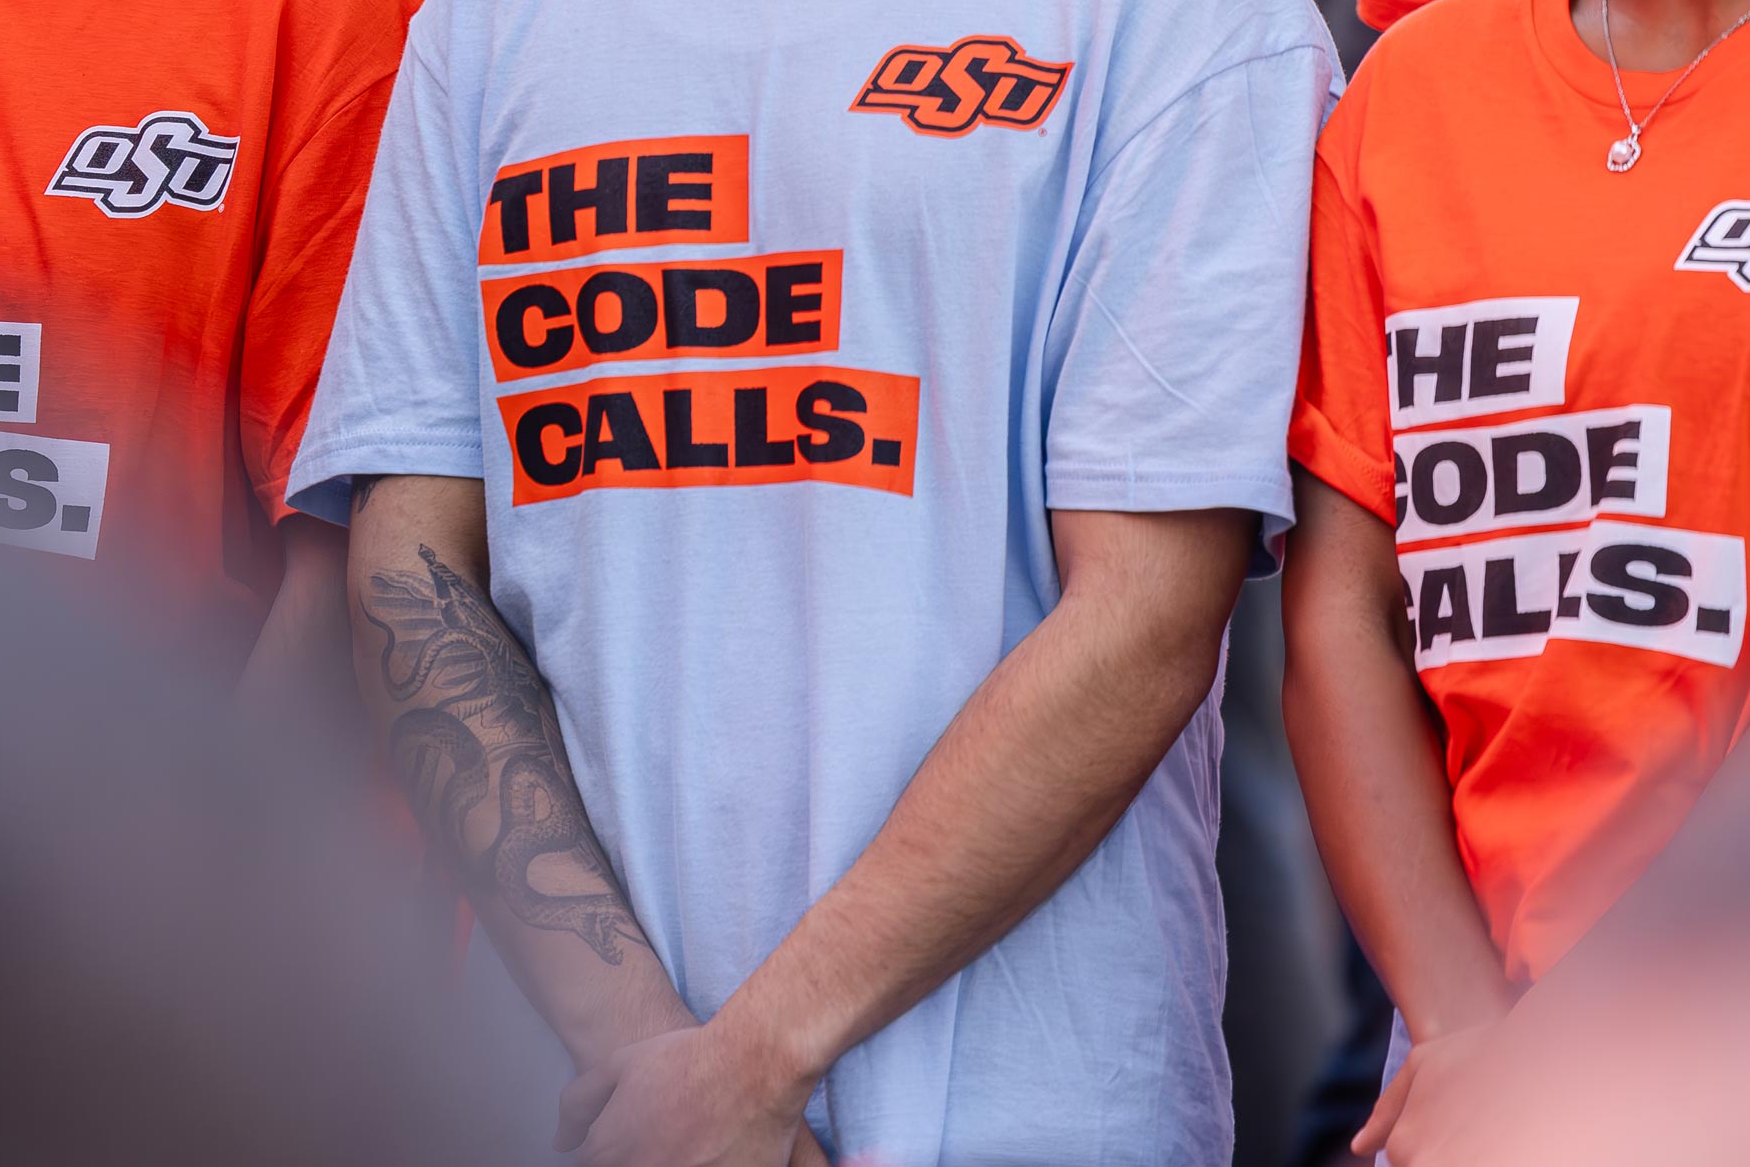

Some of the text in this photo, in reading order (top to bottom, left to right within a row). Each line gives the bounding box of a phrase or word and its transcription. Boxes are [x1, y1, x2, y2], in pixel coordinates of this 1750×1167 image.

[849, 35, 1074, 139] OSU
[45, 111, 241, 218] OSU
[490, 152, 713, 254] THE
[495, 261, 823, 368] CODE
[1387, 316, 1539, 410] HE
[515, 380, 901, 486] CALLS.
[1395, 421, 1642, 529] ODE
